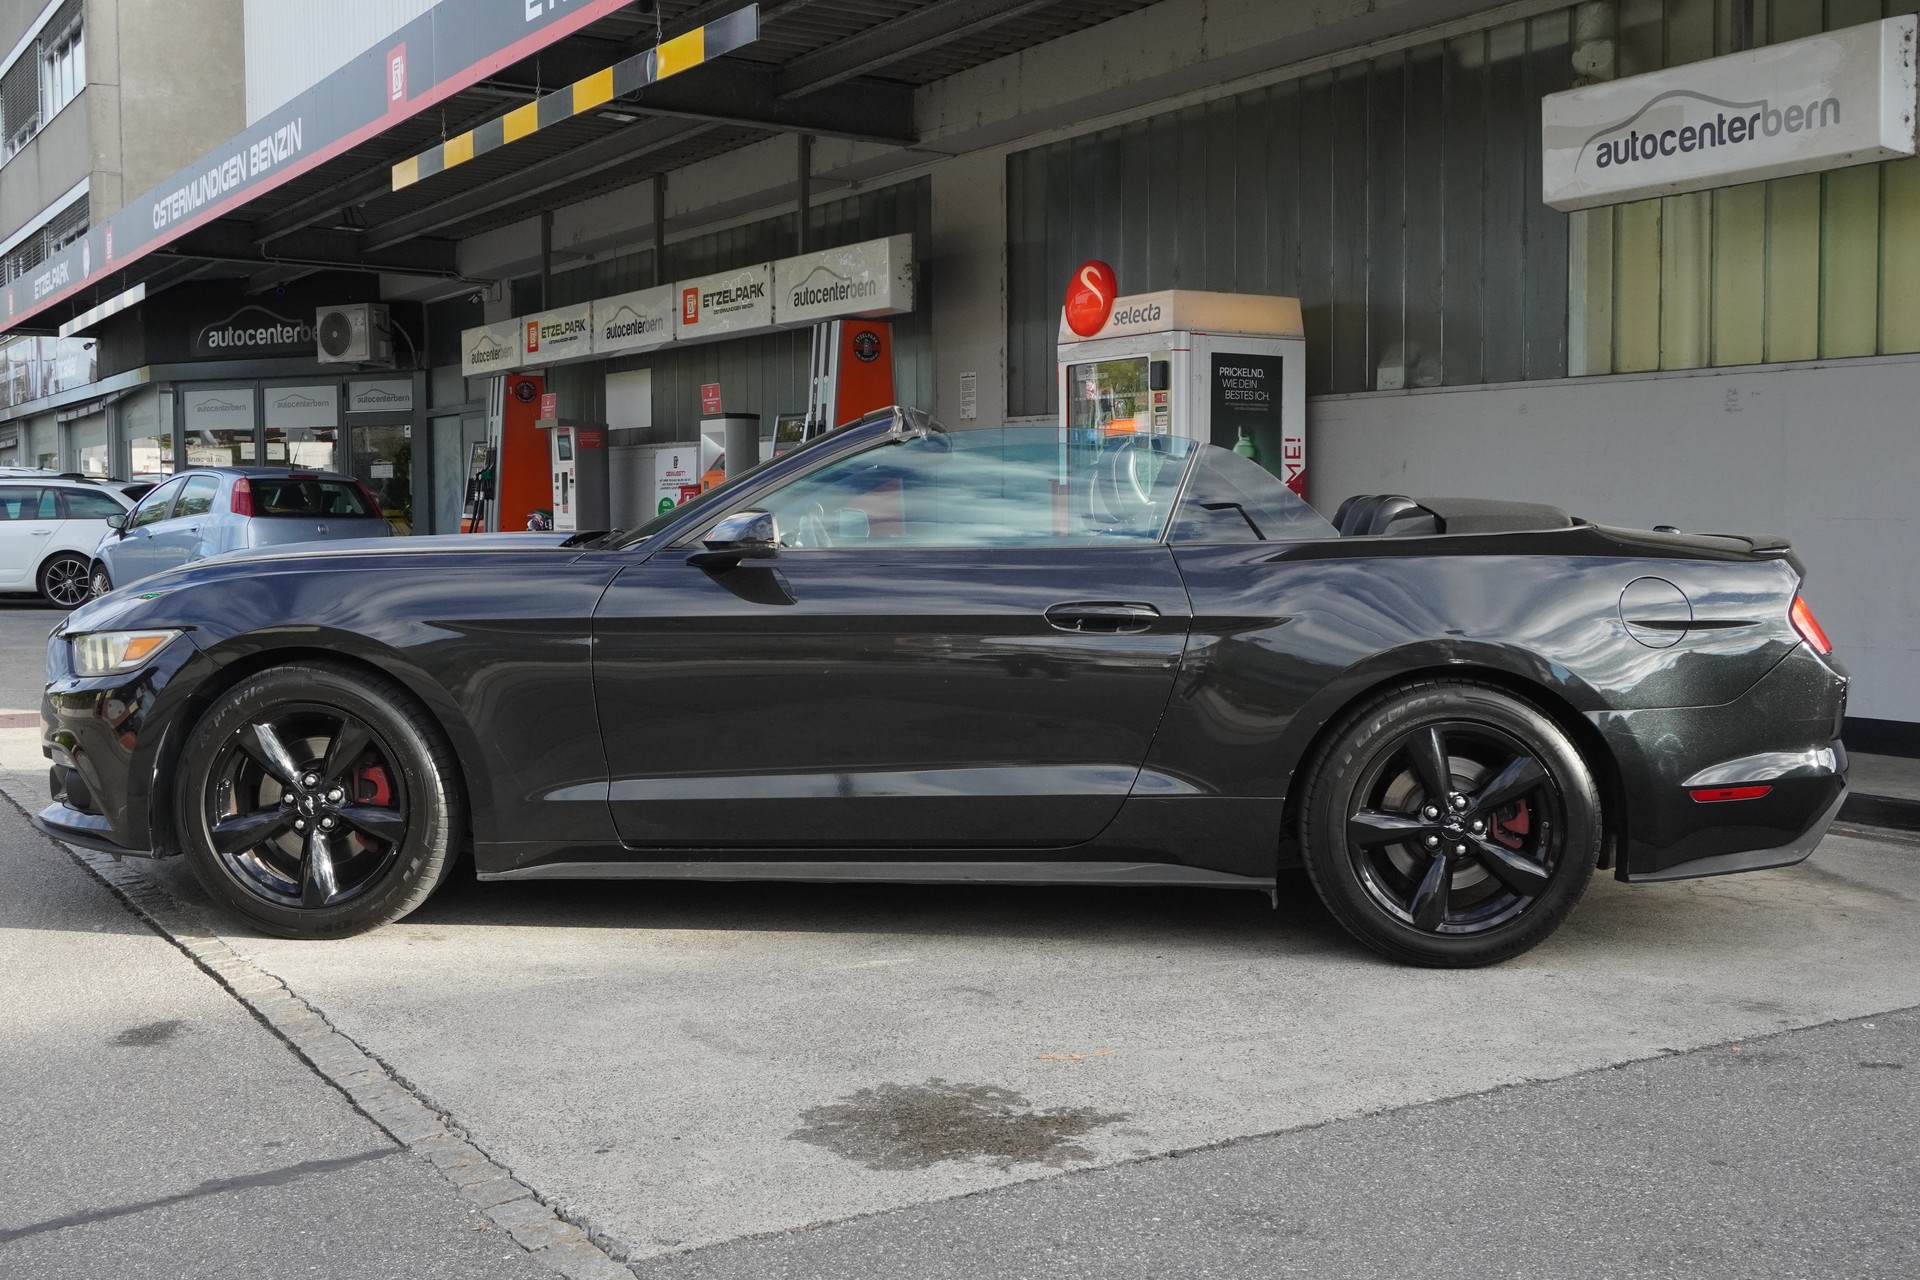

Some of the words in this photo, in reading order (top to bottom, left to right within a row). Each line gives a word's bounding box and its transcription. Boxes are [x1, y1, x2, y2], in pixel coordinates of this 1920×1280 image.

[1596, 97, 1841, 168] autocenterbern
[152, 150, 247, 230] OSTERMUNDIGEN
[250, 117, 302, 177] BENZIN
[34, 260, 70, 300] ETZELPARK
[703, 282, 765, 308] ETZELPARK
[793, 277, 876, 307] autocenterbern
[1113, 303, 1162, 326] selecta
[541, 318, 586, 339] ETZELPARK
[606, 316, 664, 339] autocenterbern
[471, 344, 514, 364] autocenterbern
[1219, 366, 1265, 379] PRICKELND,
[1222, 379, 1237, 388] WIE
[1239, 379, 1257, 389] DEIN
[277, 397, 329, 409] autocenterbern
[357, 393, 410, 404] autocenterbern
[1225, 390, 1254, 400] BESTES
[1255, 391, 1271, 401] ICH.
[196, 402, 247, 413] autocenterbern
